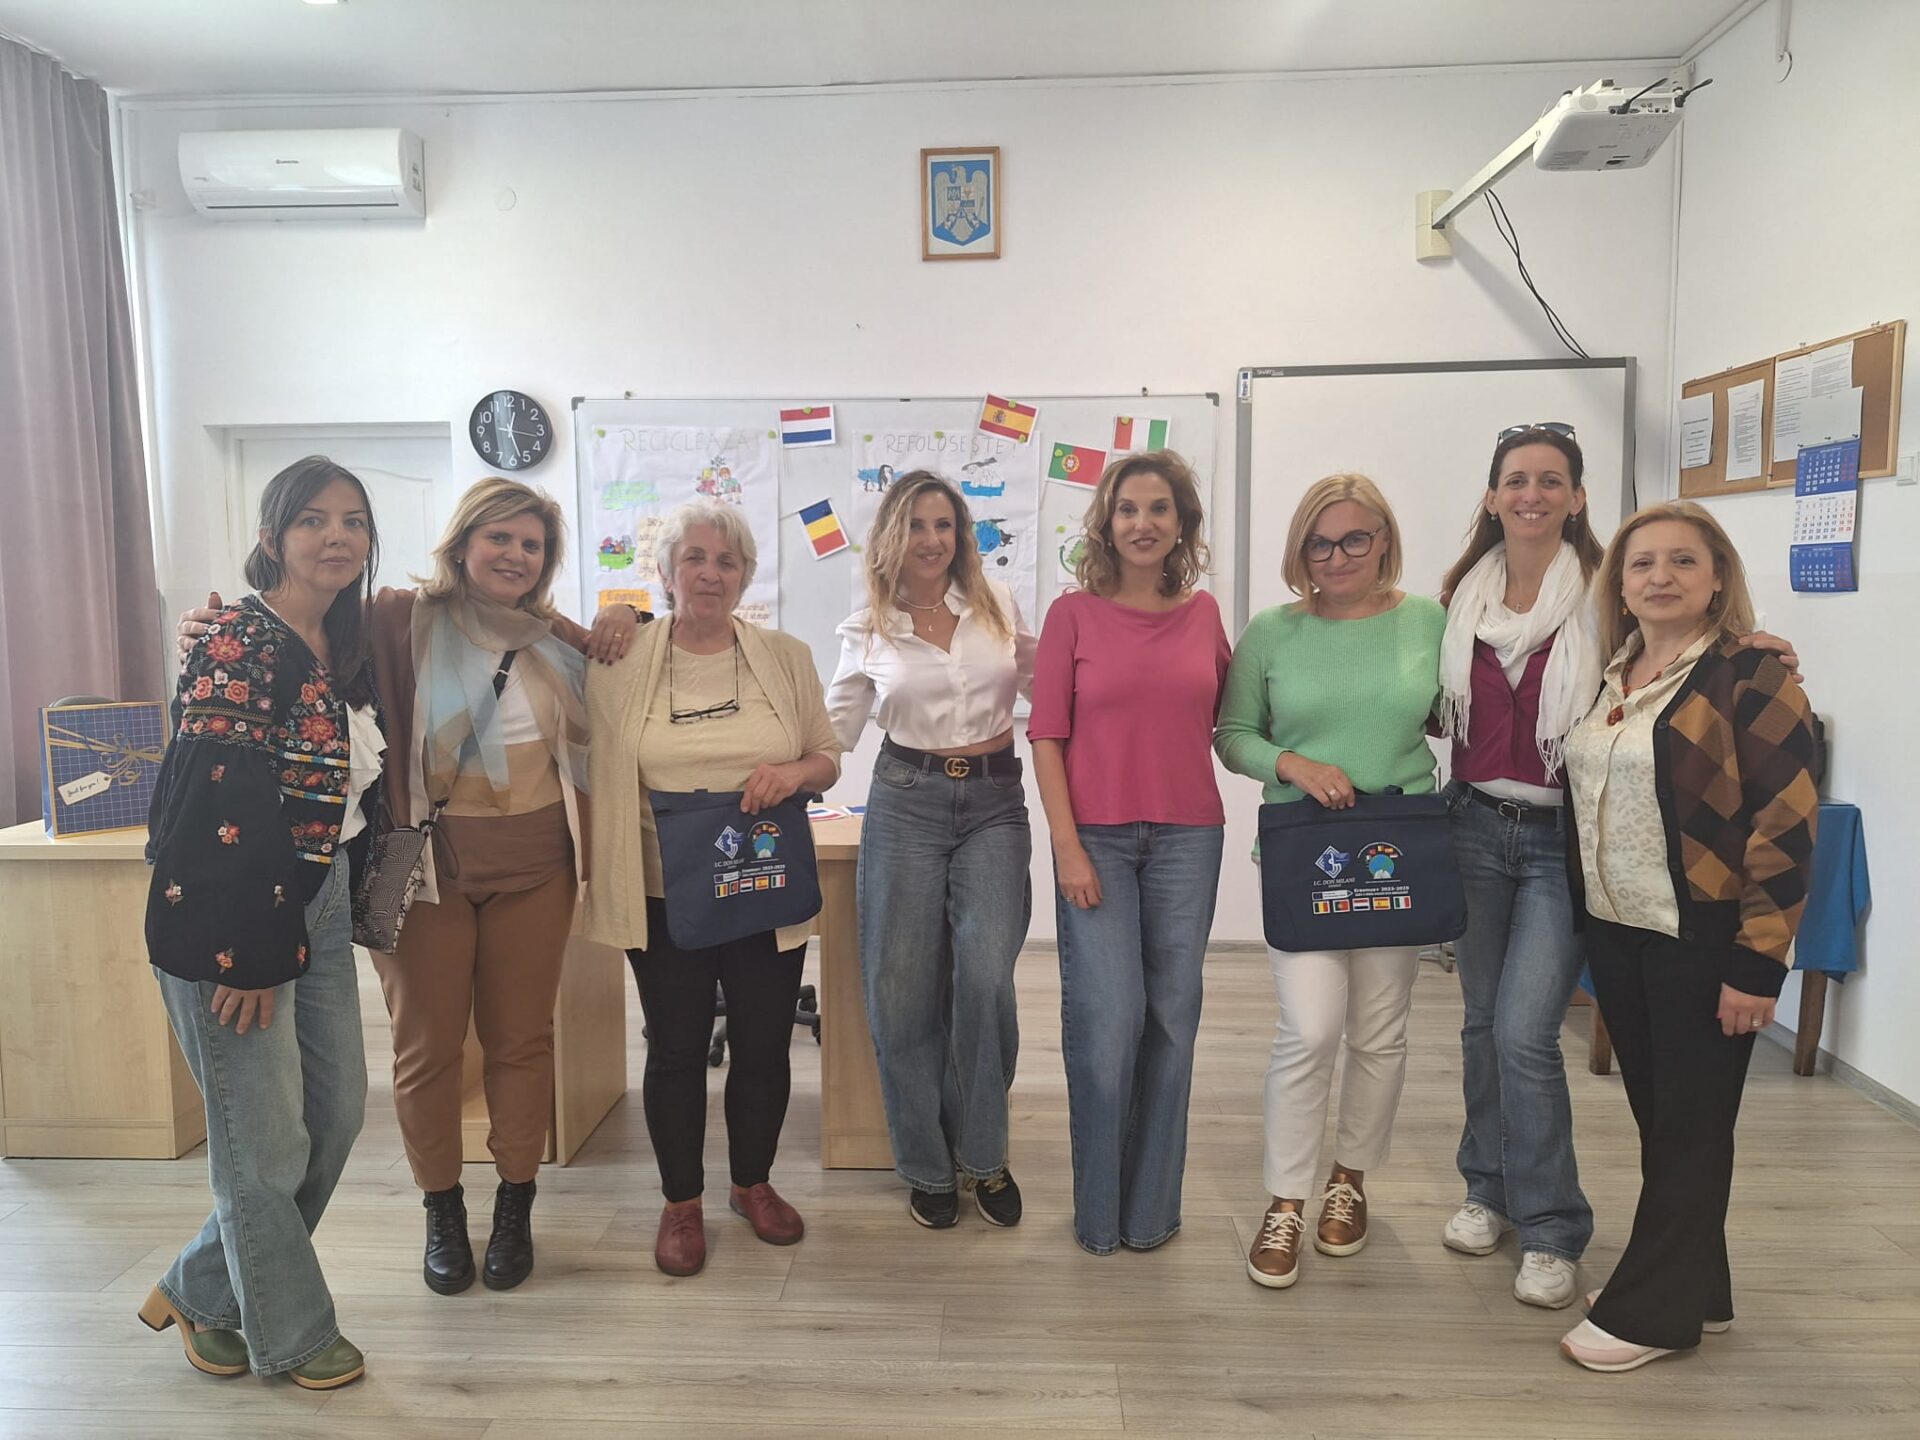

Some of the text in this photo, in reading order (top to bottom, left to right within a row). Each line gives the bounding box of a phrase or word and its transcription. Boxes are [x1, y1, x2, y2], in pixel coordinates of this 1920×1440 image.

[490, 401, 500, 413] 11
[502, 395, 515, 408] 12
[521, 399, 525, 411] 1
[480, 411, 492, 424] 10
[530, 408, 539, 420] 2
[477, 426, 485, 438] 9
[536, 424, 545, 436] 3
[483, 441, 491, 453] 8
[533, 440, 541, 451] 4
[495, 452, 503, 463] 7
[509, 454, 517, 466] 6
[523, 450, 531, 462] 5
